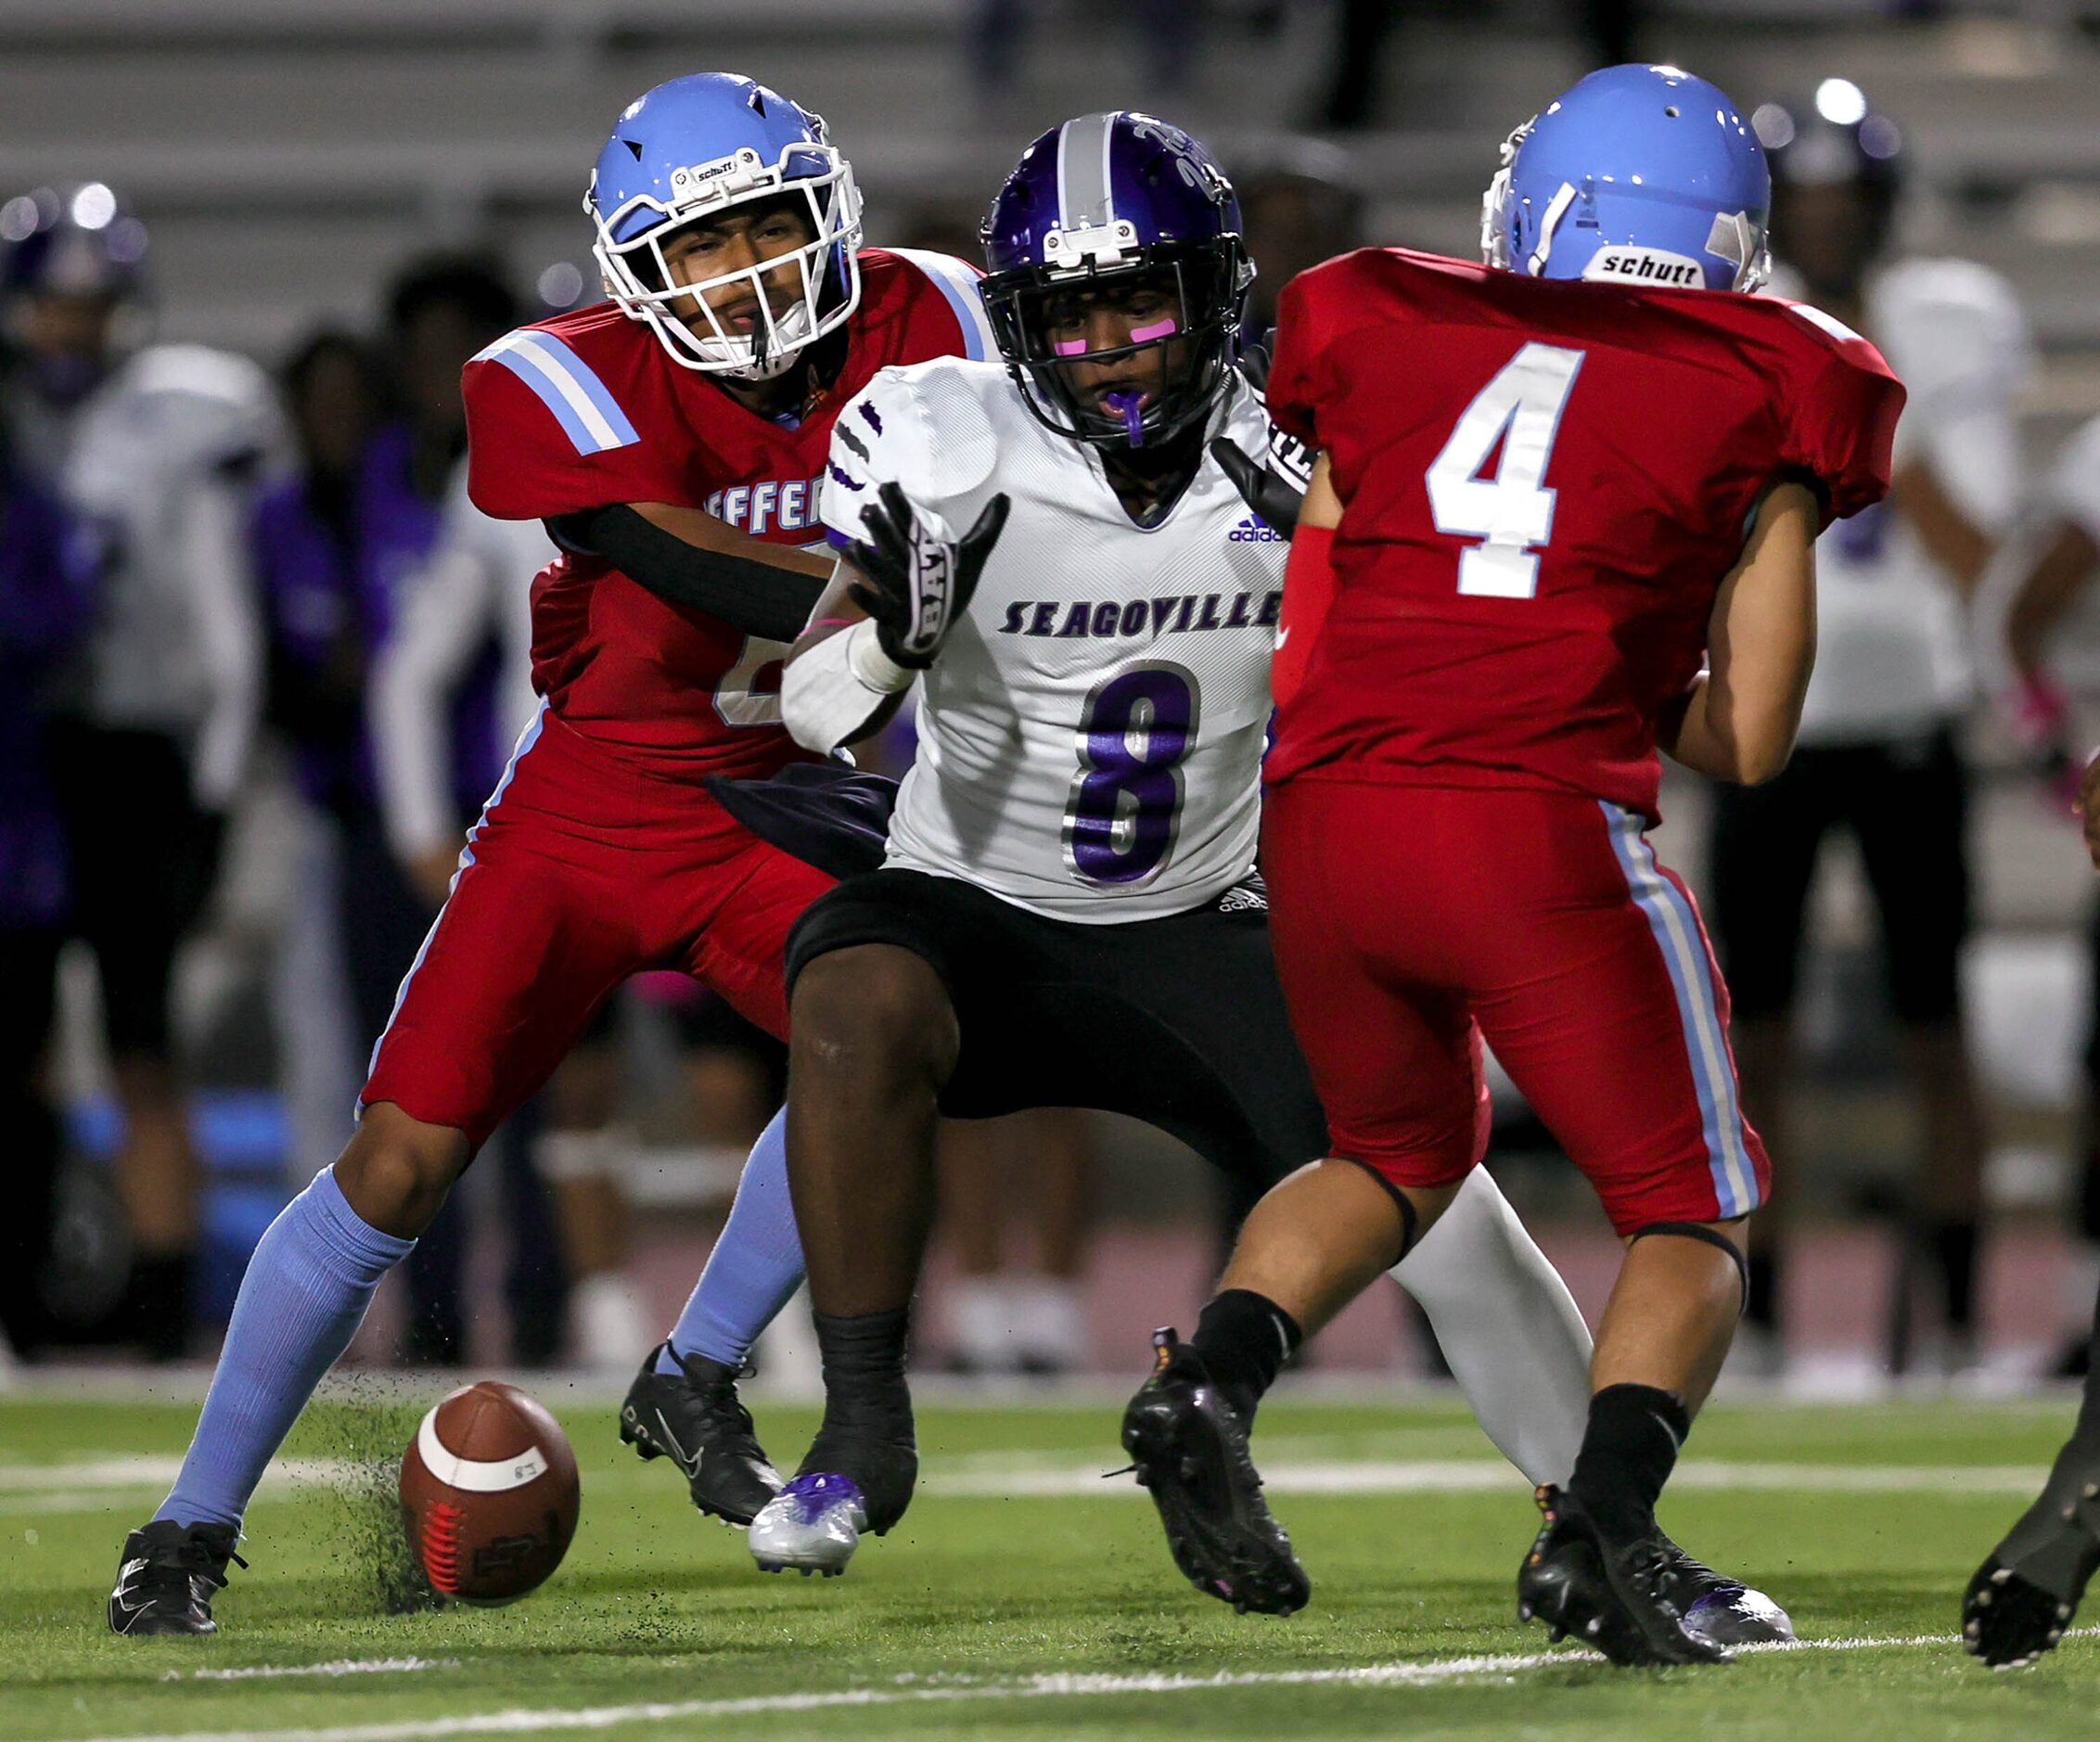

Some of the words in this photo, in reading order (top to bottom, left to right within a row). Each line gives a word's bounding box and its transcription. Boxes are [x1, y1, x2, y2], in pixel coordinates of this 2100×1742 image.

[1603, 255, 1697, 285] schutt
[1424, 339, 1587, 598] 4
[997, 589, 1284, 640] SEAGOVILLE
[1060, 658, 1201, 893] 8
